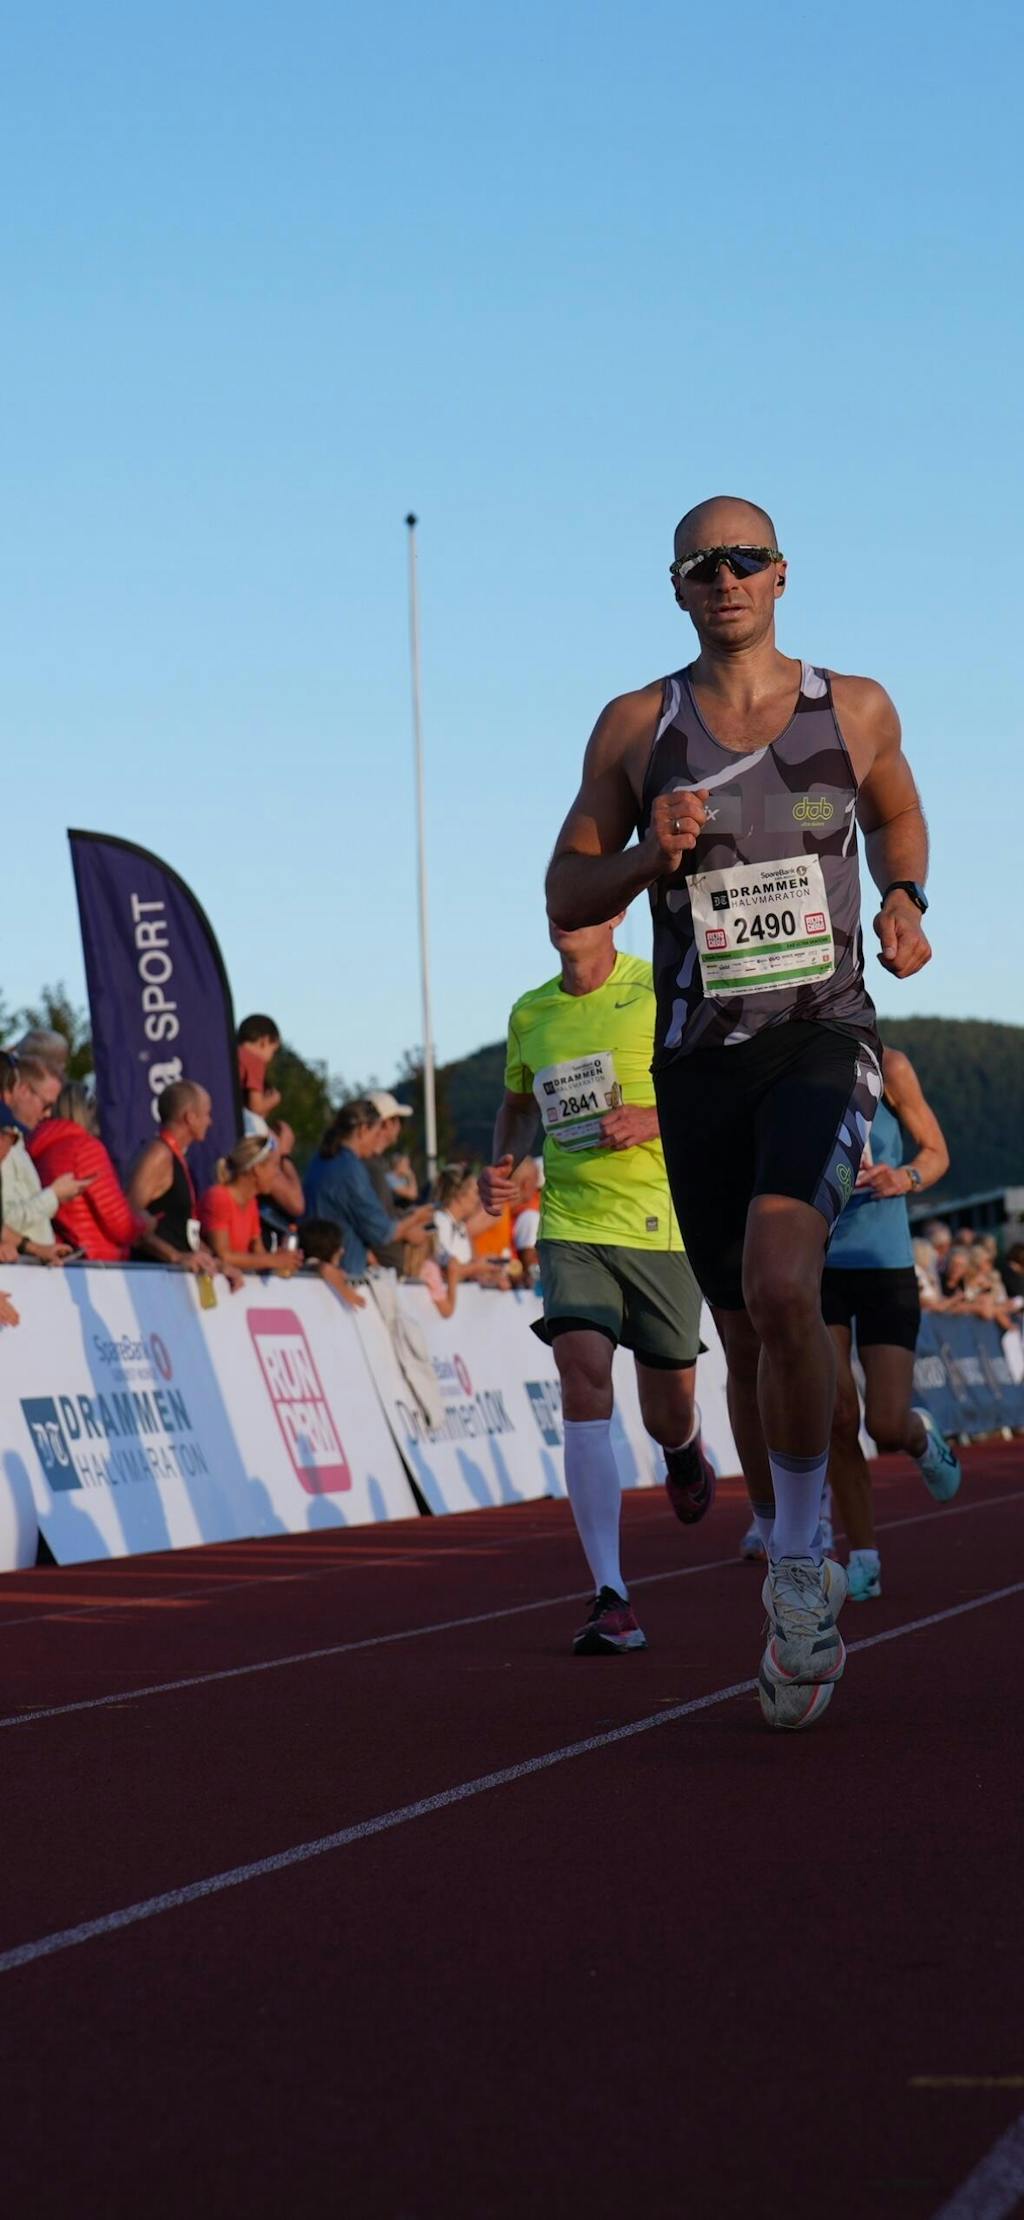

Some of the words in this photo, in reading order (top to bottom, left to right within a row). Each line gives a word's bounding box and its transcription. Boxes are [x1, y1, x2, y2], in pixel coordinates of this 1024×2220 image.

[730, 876, 809, 898] DRAMMEN
[732, 888, 811, 908] HALVMARATON
[734, 910, 796, 944] 2490
[131, 893, 179, 1041] SPORT
[554, 1067, 604, 1086] DRAMMEN
[559, 1091, 599, 1117] 2841
[265, 1347, 322, 1400] RUN
[58, 1389, 193, 1440] DRAMMEN
[395, 1389, 515, 1444] Drmen10K
[75, 1442, 209, 1488] HALVMARATON
